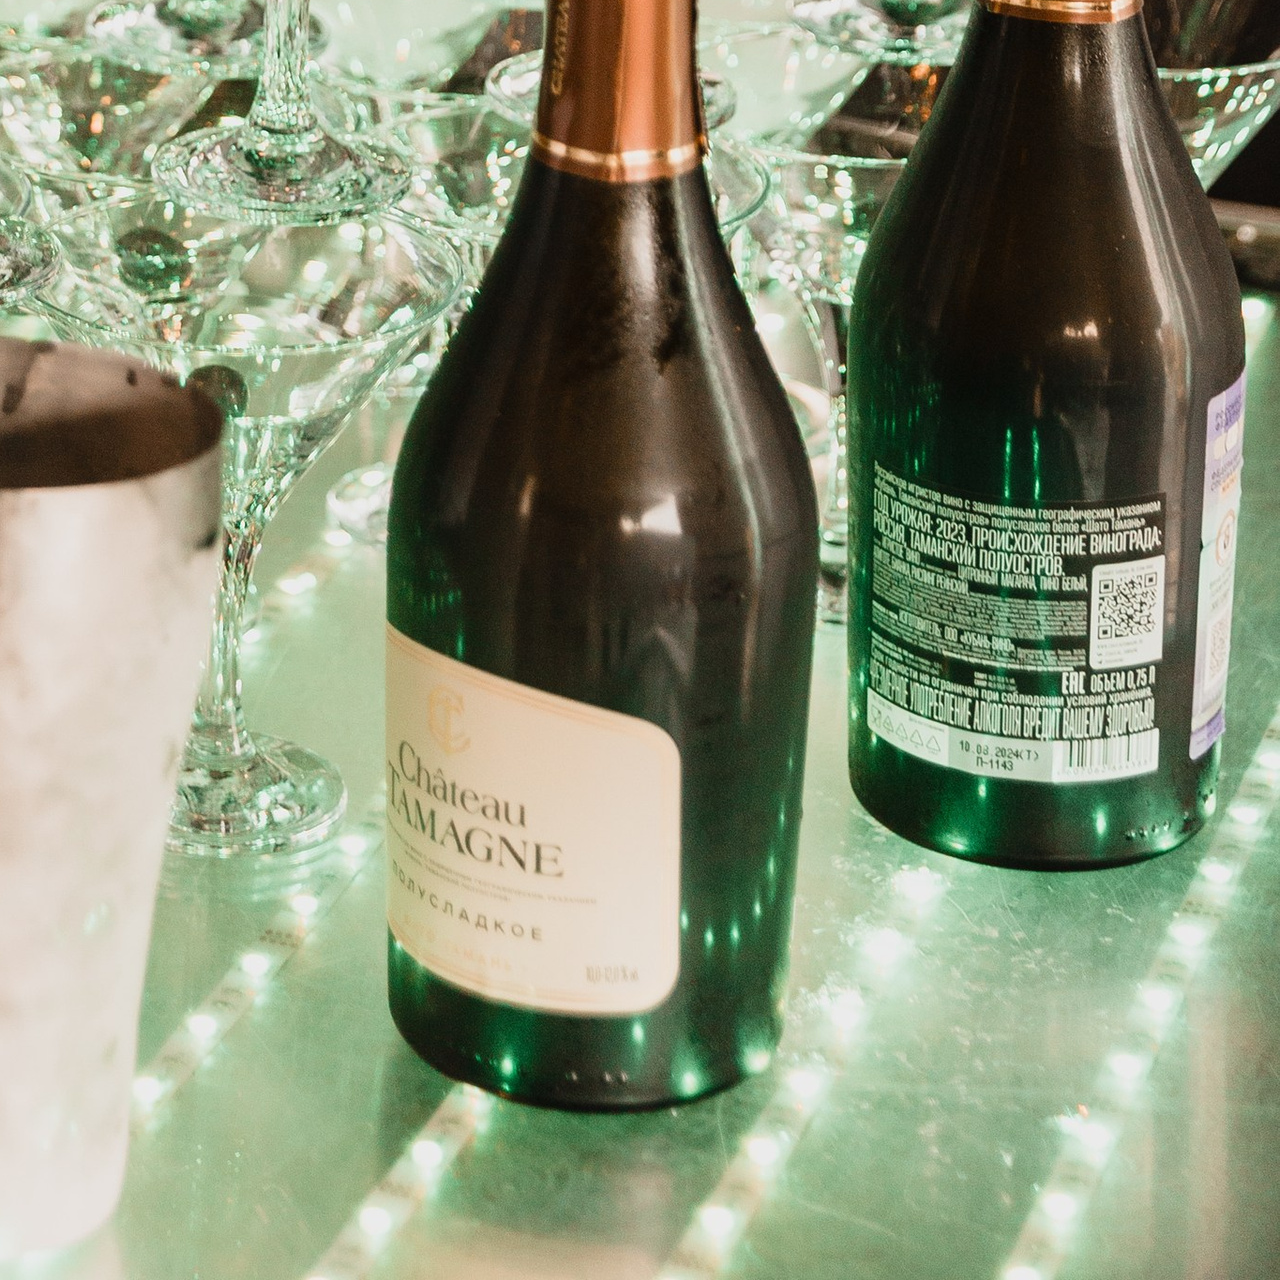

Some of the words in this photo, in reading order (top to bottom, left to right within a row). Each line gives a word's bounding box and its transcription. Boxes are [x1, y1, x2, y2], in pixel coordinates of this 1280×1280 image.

[873, 487, 890, 514] ГОД
[890, 498, 933, 535] УРОЖАЯ:
[971, 525, 1087, 556] ПРОИСХОЖДЕНИЕ
[1090, 526, 1162, 555] ВИНОГРАДА:
[942, 494, 963, 509] вино
[971, 500, 1036, 519] защищенным
[1038, 506, 1115, 522] географическим
[1116, 501, 1161, 520] указанием
[991, 517, 1051, 535] полусладкое
[1052, 520, 1079, 533] белое
[1081, 517, 1109, 532] «Шато
[1111, 518, 1146, 531] Тамань»
[873, 509, 907, 548] РОССИЯ,
[909, 528, 976, 568] ТАМАНСКИЙ
[979, 549, 1066, 577] ПОЛУОСТРОВ.
[1040, 574, 1059, 590] ПИНО
[920, 671, 930, 683] не
[931, 677, 979, 699] ограничен
[981, 689, 999, 703] при
[1001, 690, 1064, 707] соблюдении
[1066, 692, 1107, 708] условий
[1090, 671, 1125, 693] ОБЪЕМ
[1127, 669, 1147, 690] 0,75
[909, 680, 971, 729] УПОТРЕБЛЕНИЕ
[973, 699, 1021, 737] АЛКОГОЛЯ
[1023, 706, 1061, 742] ВРЕДИТ
[1062, 706, 1105, 739] ВАШЕМУ
[399, 740, 526, 828] Château
[976, 756, 1014, 771] П-1143
[388, 760, 565, 879] TAMAGNE
[392, 858, 542, 941] ПОЛУСЛАДКОЕ
